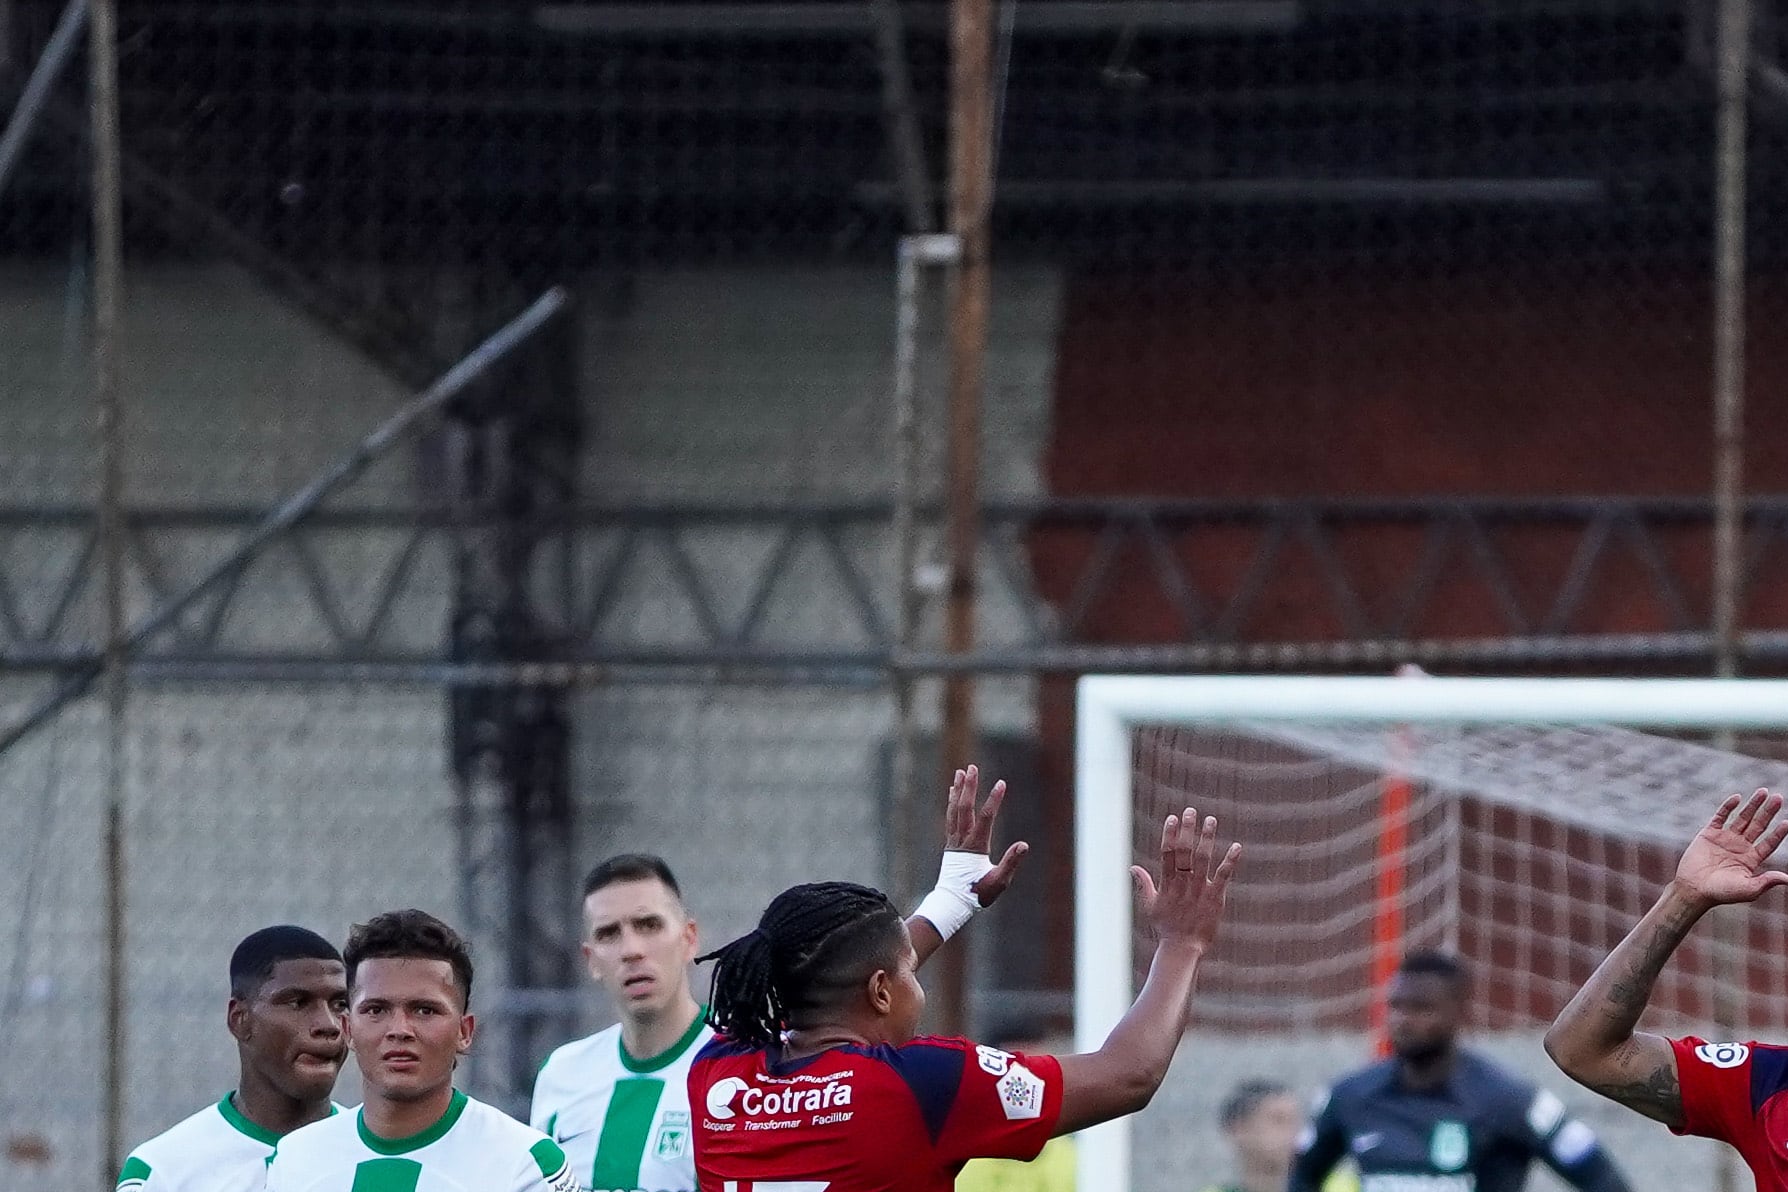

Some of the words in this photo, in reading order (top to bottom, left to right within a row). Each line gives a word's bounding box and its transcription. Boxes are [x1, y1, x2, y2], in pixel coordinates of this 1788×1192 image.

[743, 1081, 852, 1116] Cotrafa
[744, 1119, 801, 1131] Transformar
[812, 1111, 854, 1126] Facilitar
